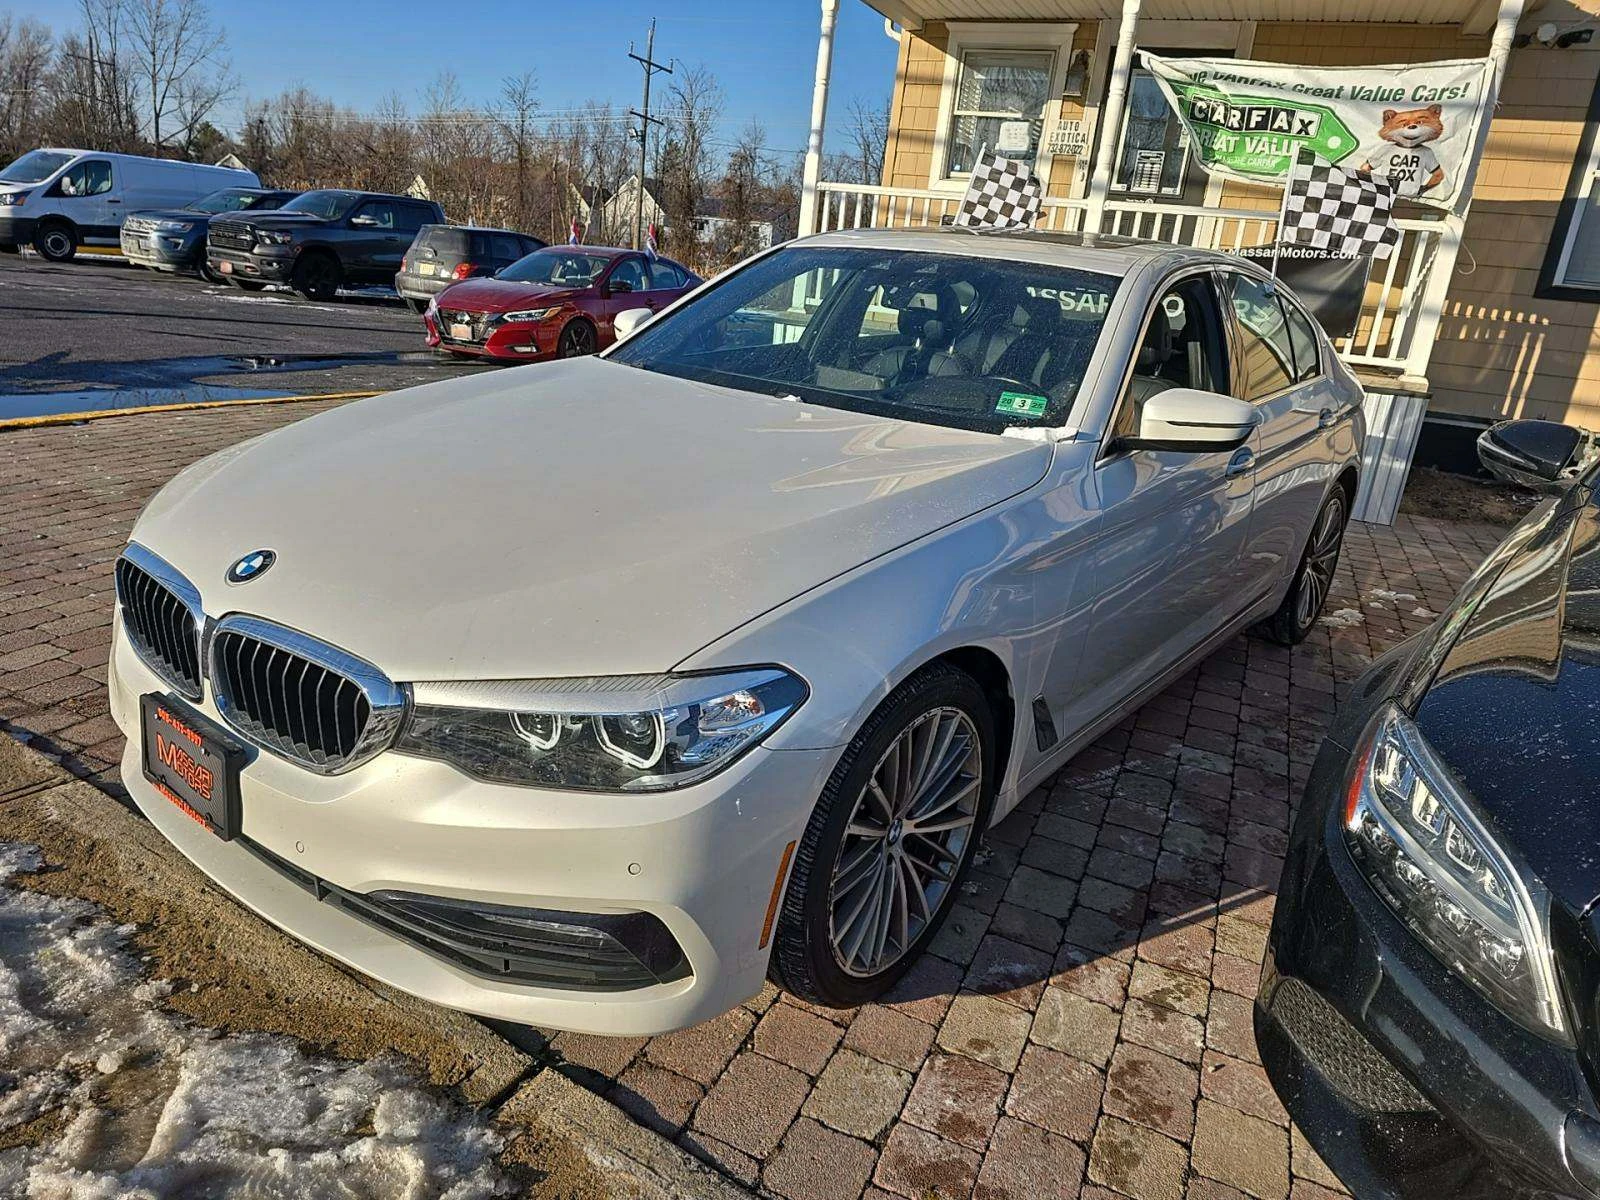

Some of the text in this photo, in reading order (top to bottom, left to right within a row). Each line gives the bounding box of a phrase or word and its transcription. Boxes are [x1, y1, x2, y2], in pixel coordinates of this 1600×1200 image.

[1292, 82, 1344, 100] Great
[1350, 85, 1406, 102] Value
[1411, 82, 1470, 102] Cars!
[1193, 99, 1316, 137] CARFAX
[1057, 120, 1080, 132] AUTO
[1050, 132, 1086, 144] EXOTICA
[1389, 154, 1421, 168] CAR
[1388, 168, 1417, 183] FOX
[1018, 399, 1026, 408] 3
